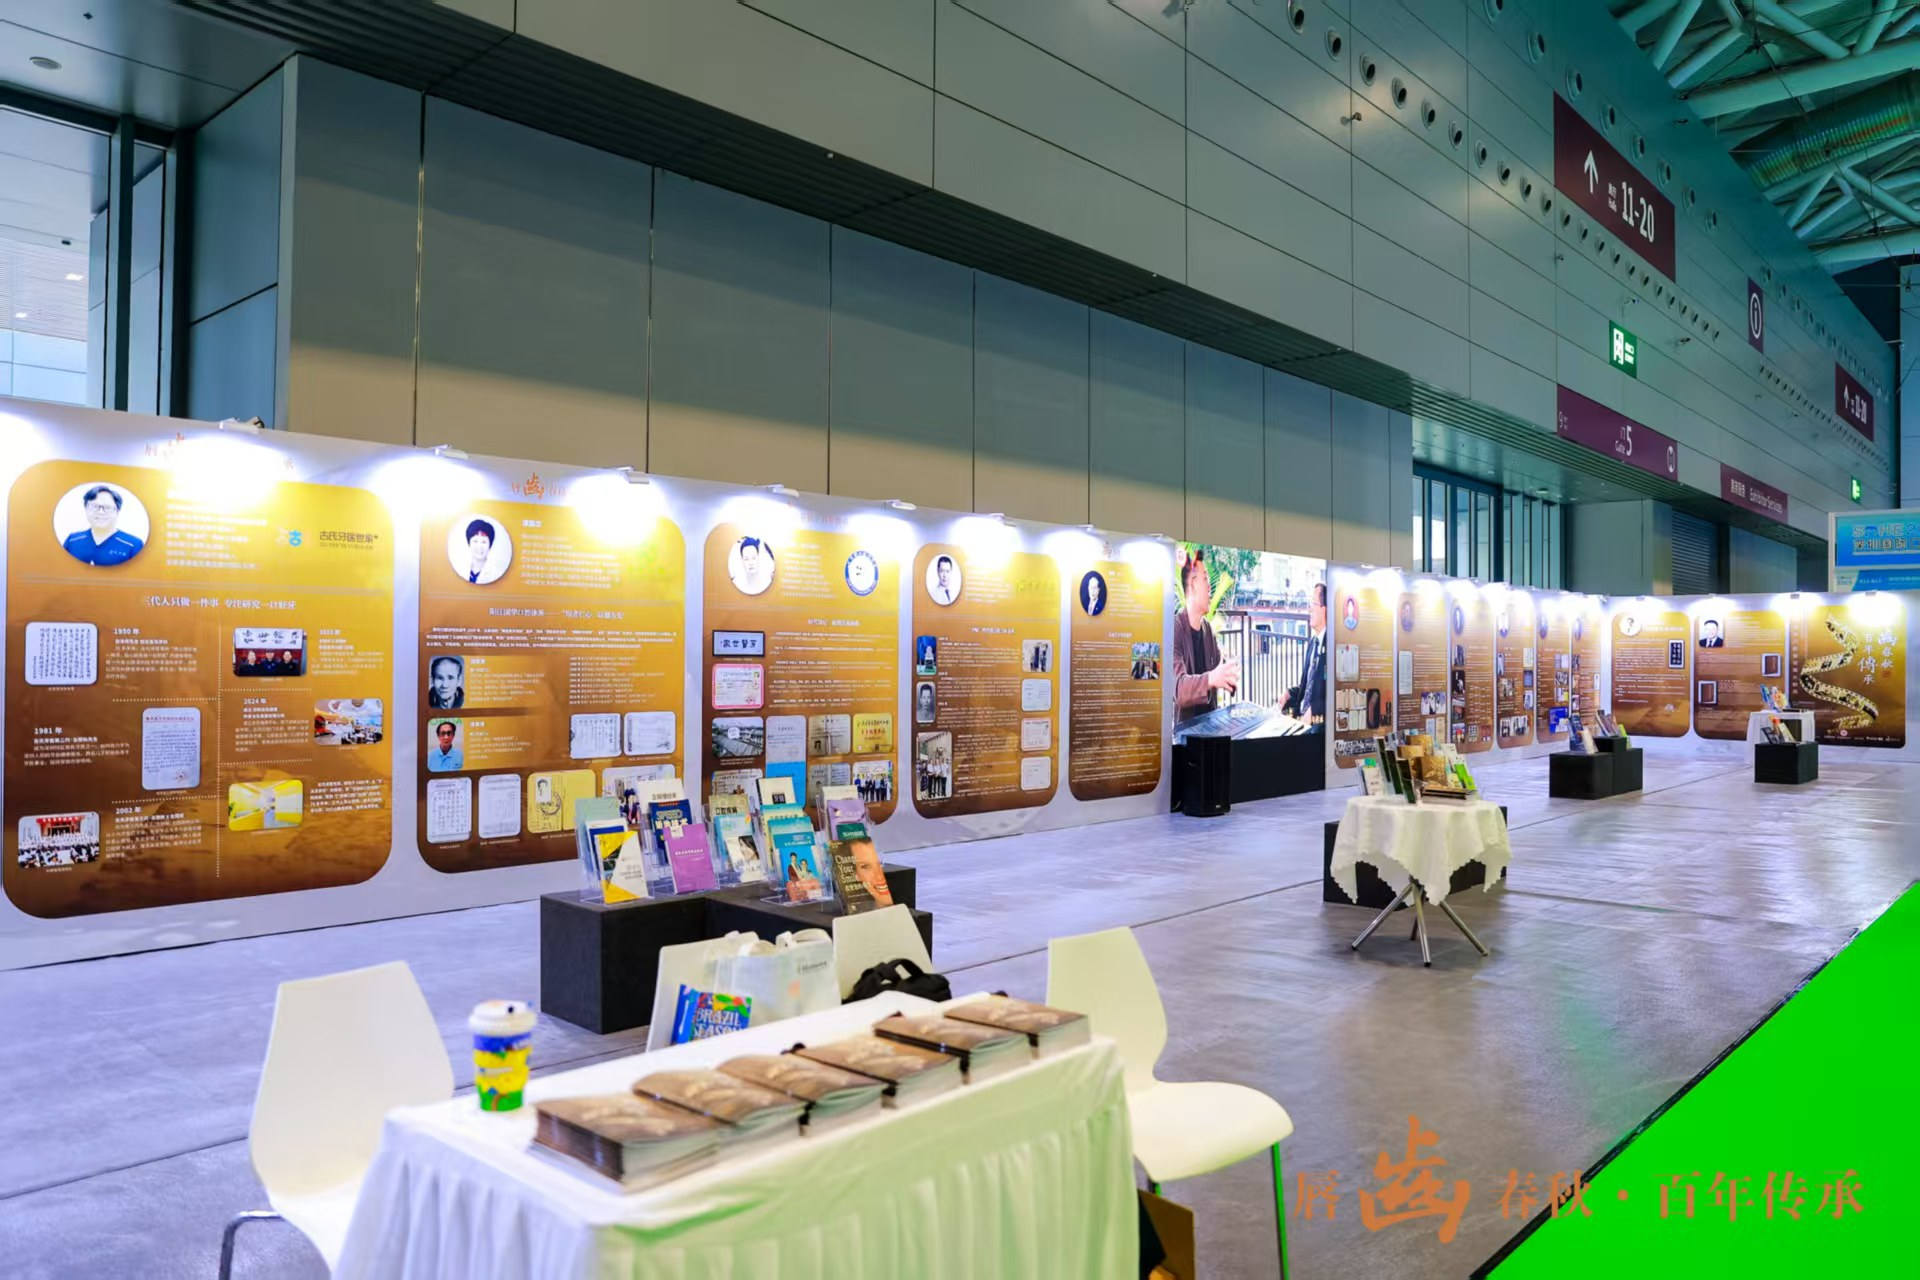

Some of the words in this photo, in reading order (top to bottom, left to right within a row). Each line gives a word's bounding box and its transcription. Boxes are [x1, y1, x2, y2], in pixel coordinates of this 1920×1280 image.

[1622, 181, 1655, 243] 11-20
[1626, 425, 1633, 457] 5
[34, 727, 53, 735] 1981
[116, 807, 133, 815] 2002
[838, 864, 854, 875] Your
[697, 1008, 740, 1027] BRAZIL
